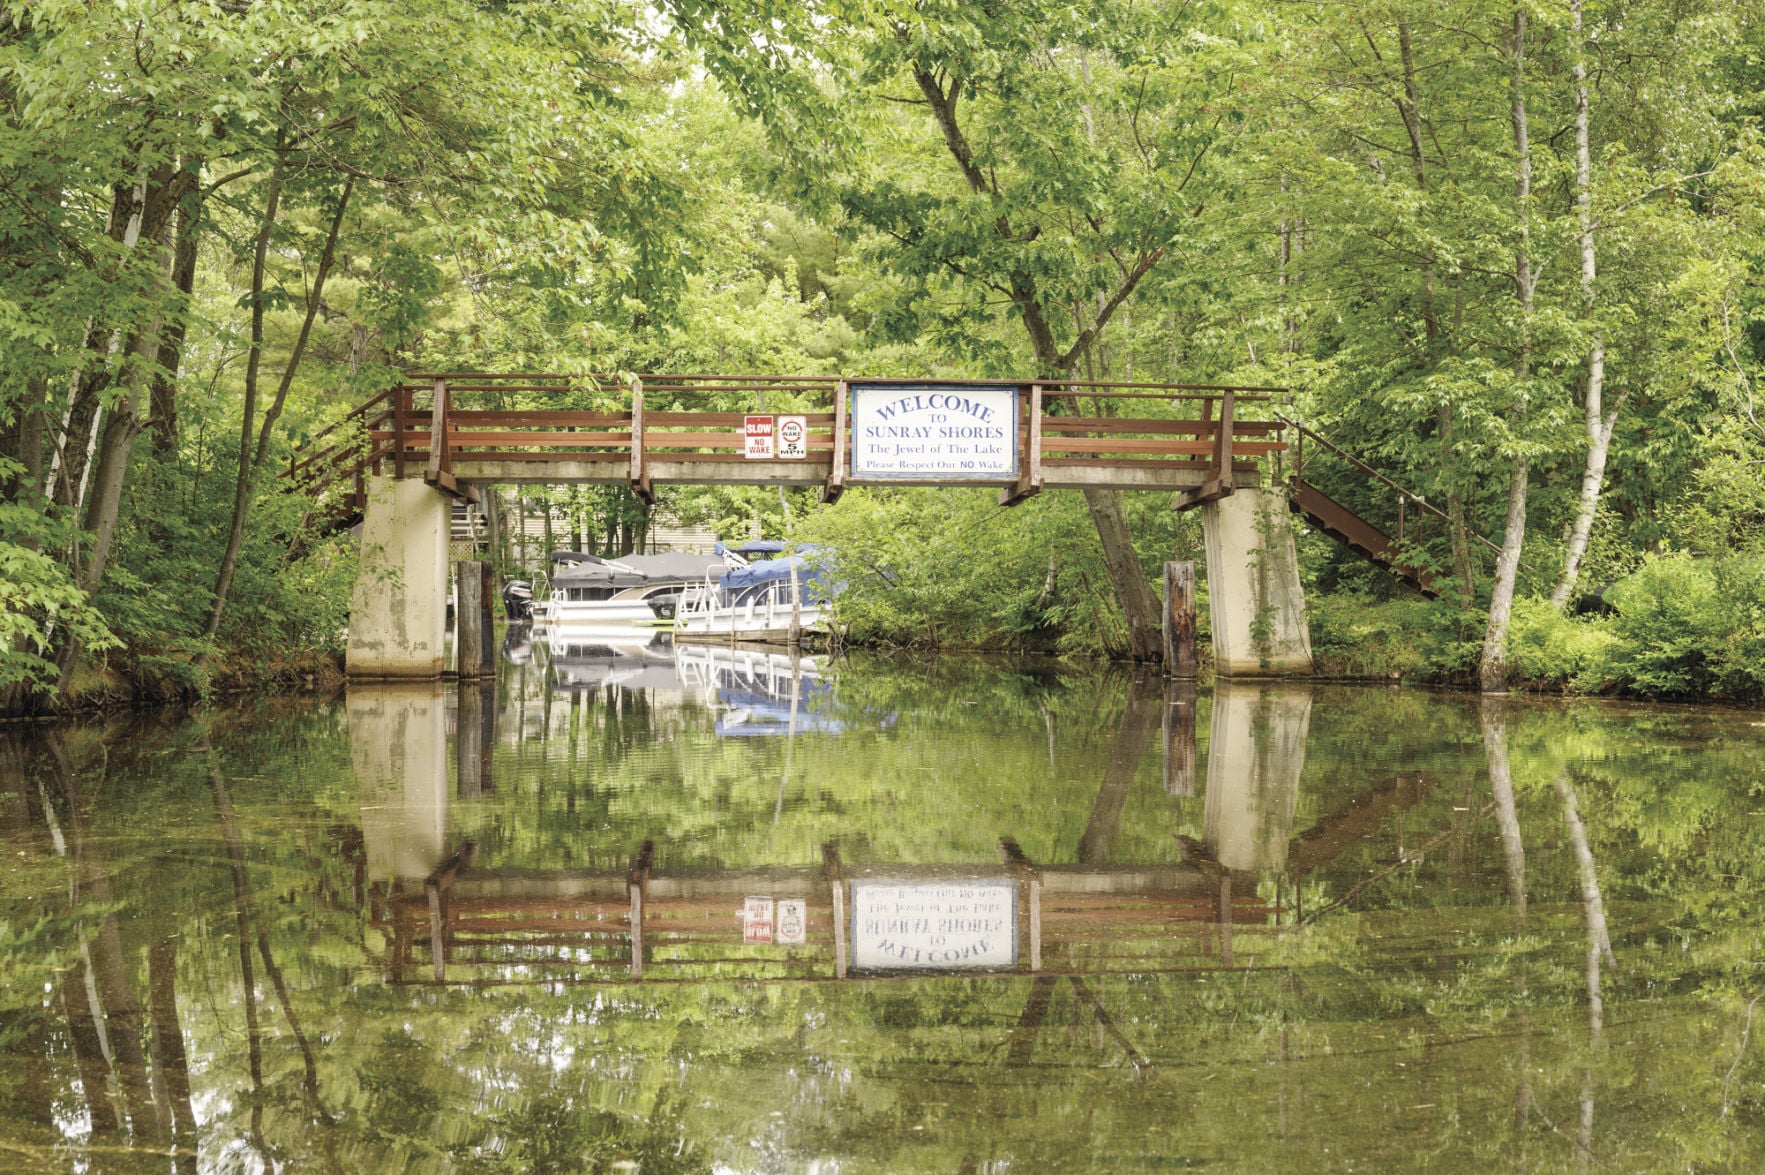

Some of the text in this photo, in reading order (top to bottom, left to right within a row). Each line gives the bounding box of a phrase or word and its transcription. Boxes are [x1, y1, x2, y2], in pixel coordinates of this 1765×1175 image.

[876, 393, 995, 424] WELCOME
[928, 413, 947, 424] TO
[747, 424, 771, 433] SLOW
[866, 426, 1004, 438] SUNRAY SHORES
[868, 443, 1002, 456] The Jewel of The Lake
[866, 460, 1004, 471] Please Respect Our NO Wake
